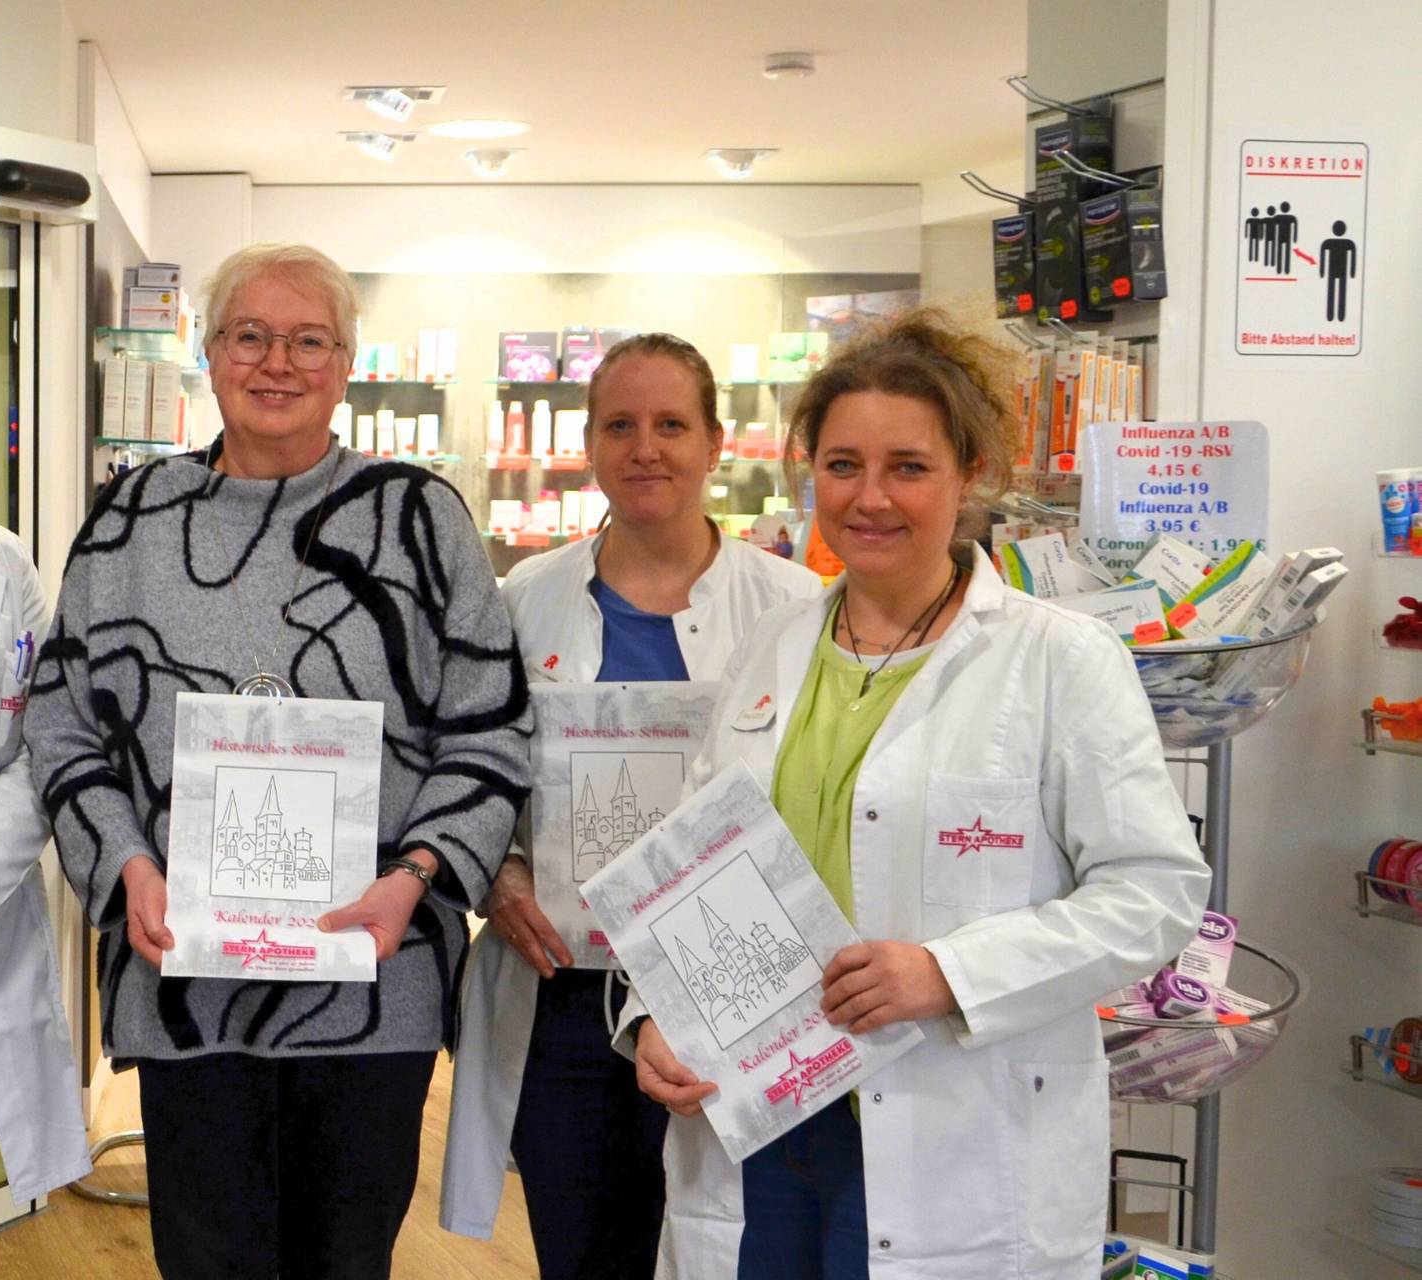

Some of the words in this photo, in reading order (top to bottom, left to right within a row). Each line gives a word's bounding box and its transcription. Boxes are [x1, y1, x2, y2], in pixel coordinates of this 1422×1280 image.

[1245, 156, 1364, 170] DISKRETION
[1241, 332, 1268, 345] Bitte
[1270, 333, 1315, 346] Abstand
[1318, 333, 1356, 346] halten!
[1122, 426, 1195, 440] Influenza
[1200, 425, 1230, 440] A/B
[1116, 444, 1160, 458] Covid
[1165, 445, 1192, 458] -19
[1197, 444, 1235, 458] -RSV
[1147, 464, 1185, 478] 4,15
[1191, 463, 1203, 477] €
[1138, 482, 1210, 495] Covid-19
[1119, 501, 1193, 514] Influenza
[1198, 501, 1229, 516] A/B
[1190, 519, 1201, 533] €
[1098, 537, 1145, 550] Coron
[1212, 538, 1246, 553] 1,9
[1099, 556, 1134, 570] Coro
[564, 722, 635, 738] Historisches
[639, 723, 690, 738] Schwelm
[212, 737, 287, 754] Historisches
[291, 740, 346, 757] Schwelm
[939, 834, 972, 843] STERN
[974, 835, 1024, 845] APOTHEKE
[630, 863, 696, 915] Historisches
[696, 824, 745, 866] Schwelm
[214, 909, 282, 926] Kalender
[287, 915, 316, 929] 202
[1201, 920, 1228, 936] sla
[223, 944, 256, 954] STERN
[259, 946, 316, 956] APOTHEKE
[1175, 979, 1204, 999] isla
[738, 1024, 799, 1074] Kalender
[767, 1077, 798, 1101] STERN
[798, 1038, 852, 1080] APOTHEKE
